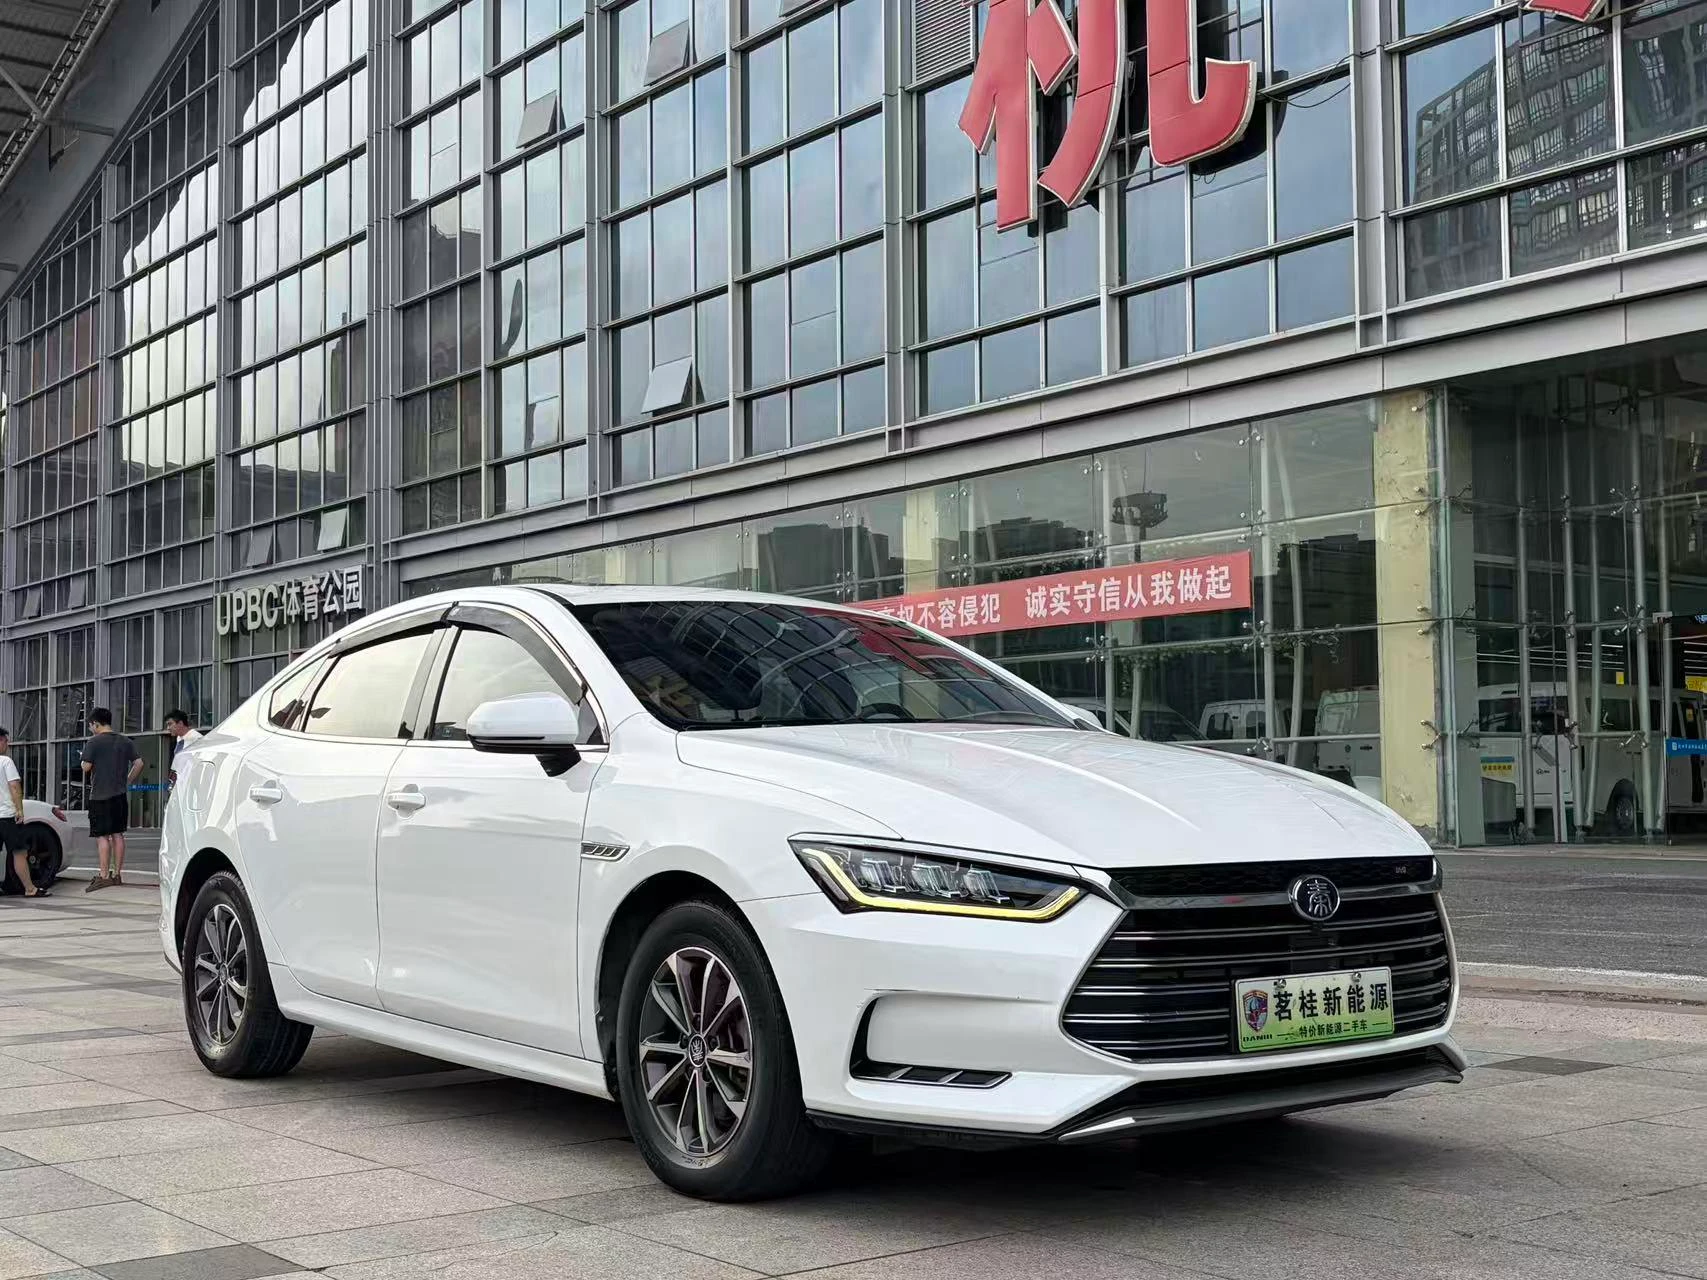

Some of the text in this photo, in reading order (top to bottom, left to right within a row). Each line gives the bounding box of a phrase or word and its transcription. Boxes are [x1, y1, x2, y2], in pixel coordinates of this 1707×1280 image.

[1024, 564, 1232, 619] 诚实守信从我做起
[1273, 982, 1390, 1022] 茗桂新能源
[1299, 1018, 1368, 1038] 特价新能源二手车
